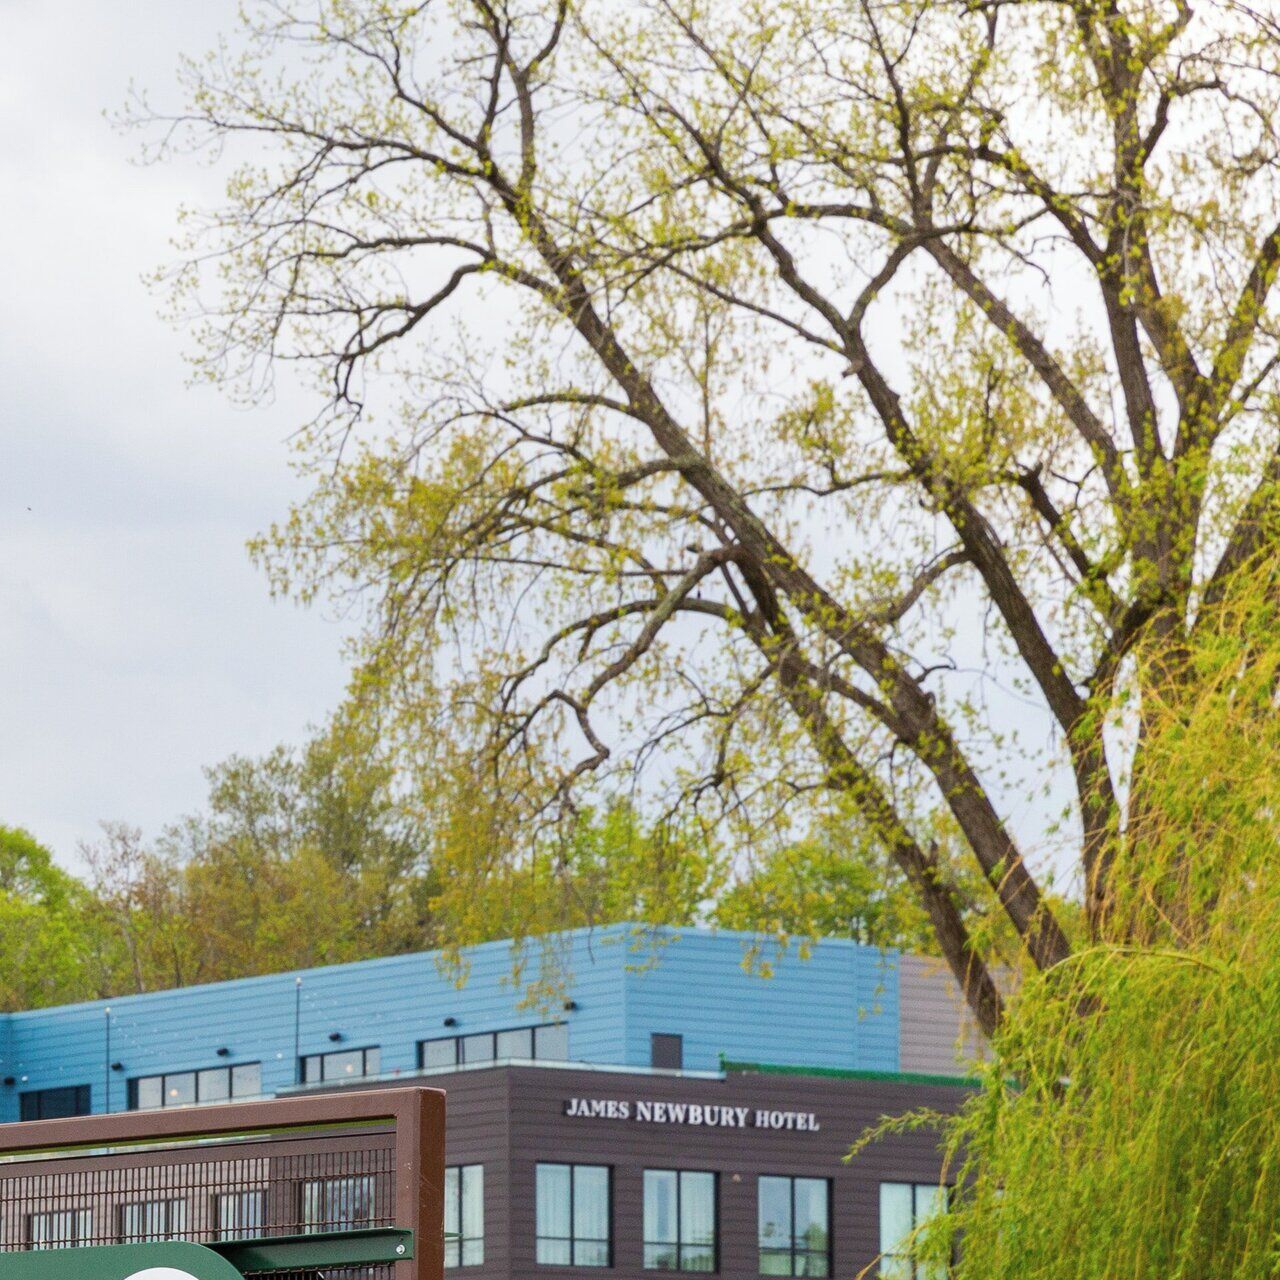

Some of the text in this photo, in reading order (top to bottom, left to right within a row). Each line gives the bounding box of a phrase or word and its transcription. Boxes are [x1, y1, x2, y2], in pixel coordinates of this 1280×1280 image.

[566, 1098, 821, 1132] JAMES NEWBURY HOTEL
